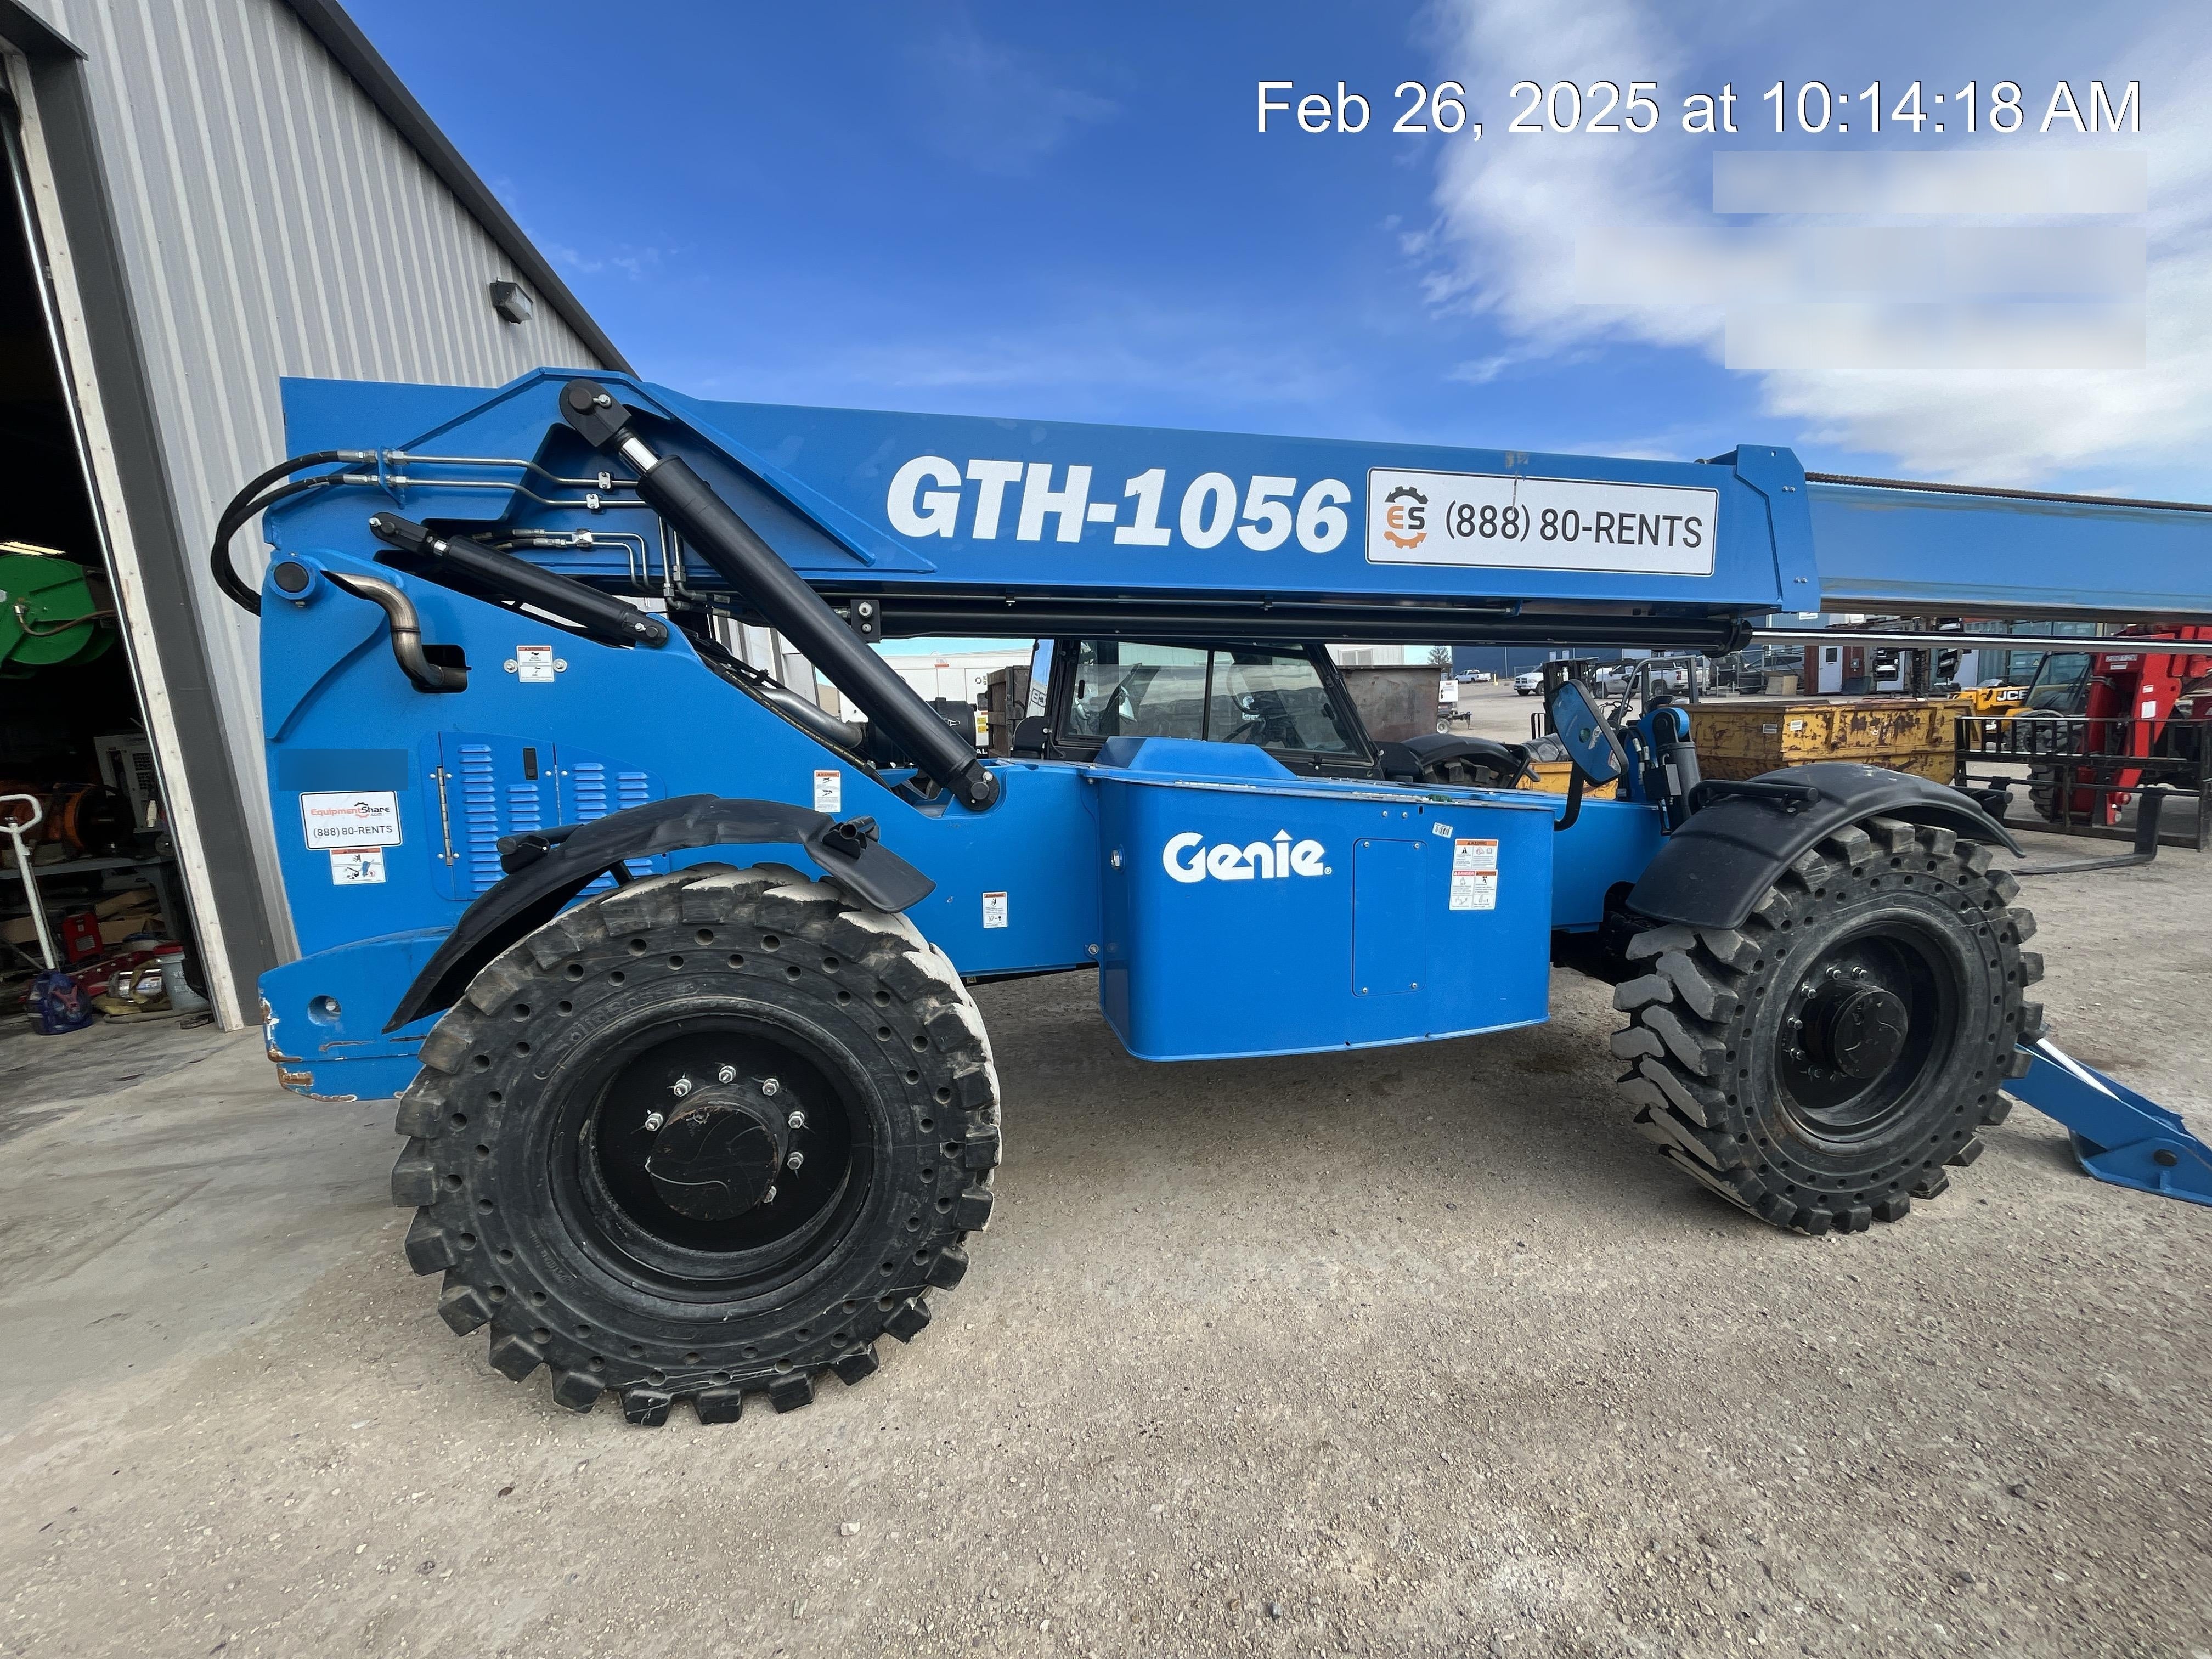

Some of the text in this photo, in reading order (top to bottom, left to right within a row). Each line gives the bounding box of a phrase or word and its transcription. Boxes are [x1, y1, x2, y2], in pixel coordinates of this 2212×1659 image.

[886, 455, 1352, 554] GTH-1056
[1446, 500, 1703, 548] (888) 80-RENTS
[311, 806, 390, 816] EquipmentShare
[313, 825, 393, 839] (888) 80-RENTS
[1163, 829, 1325, 883] Genie
